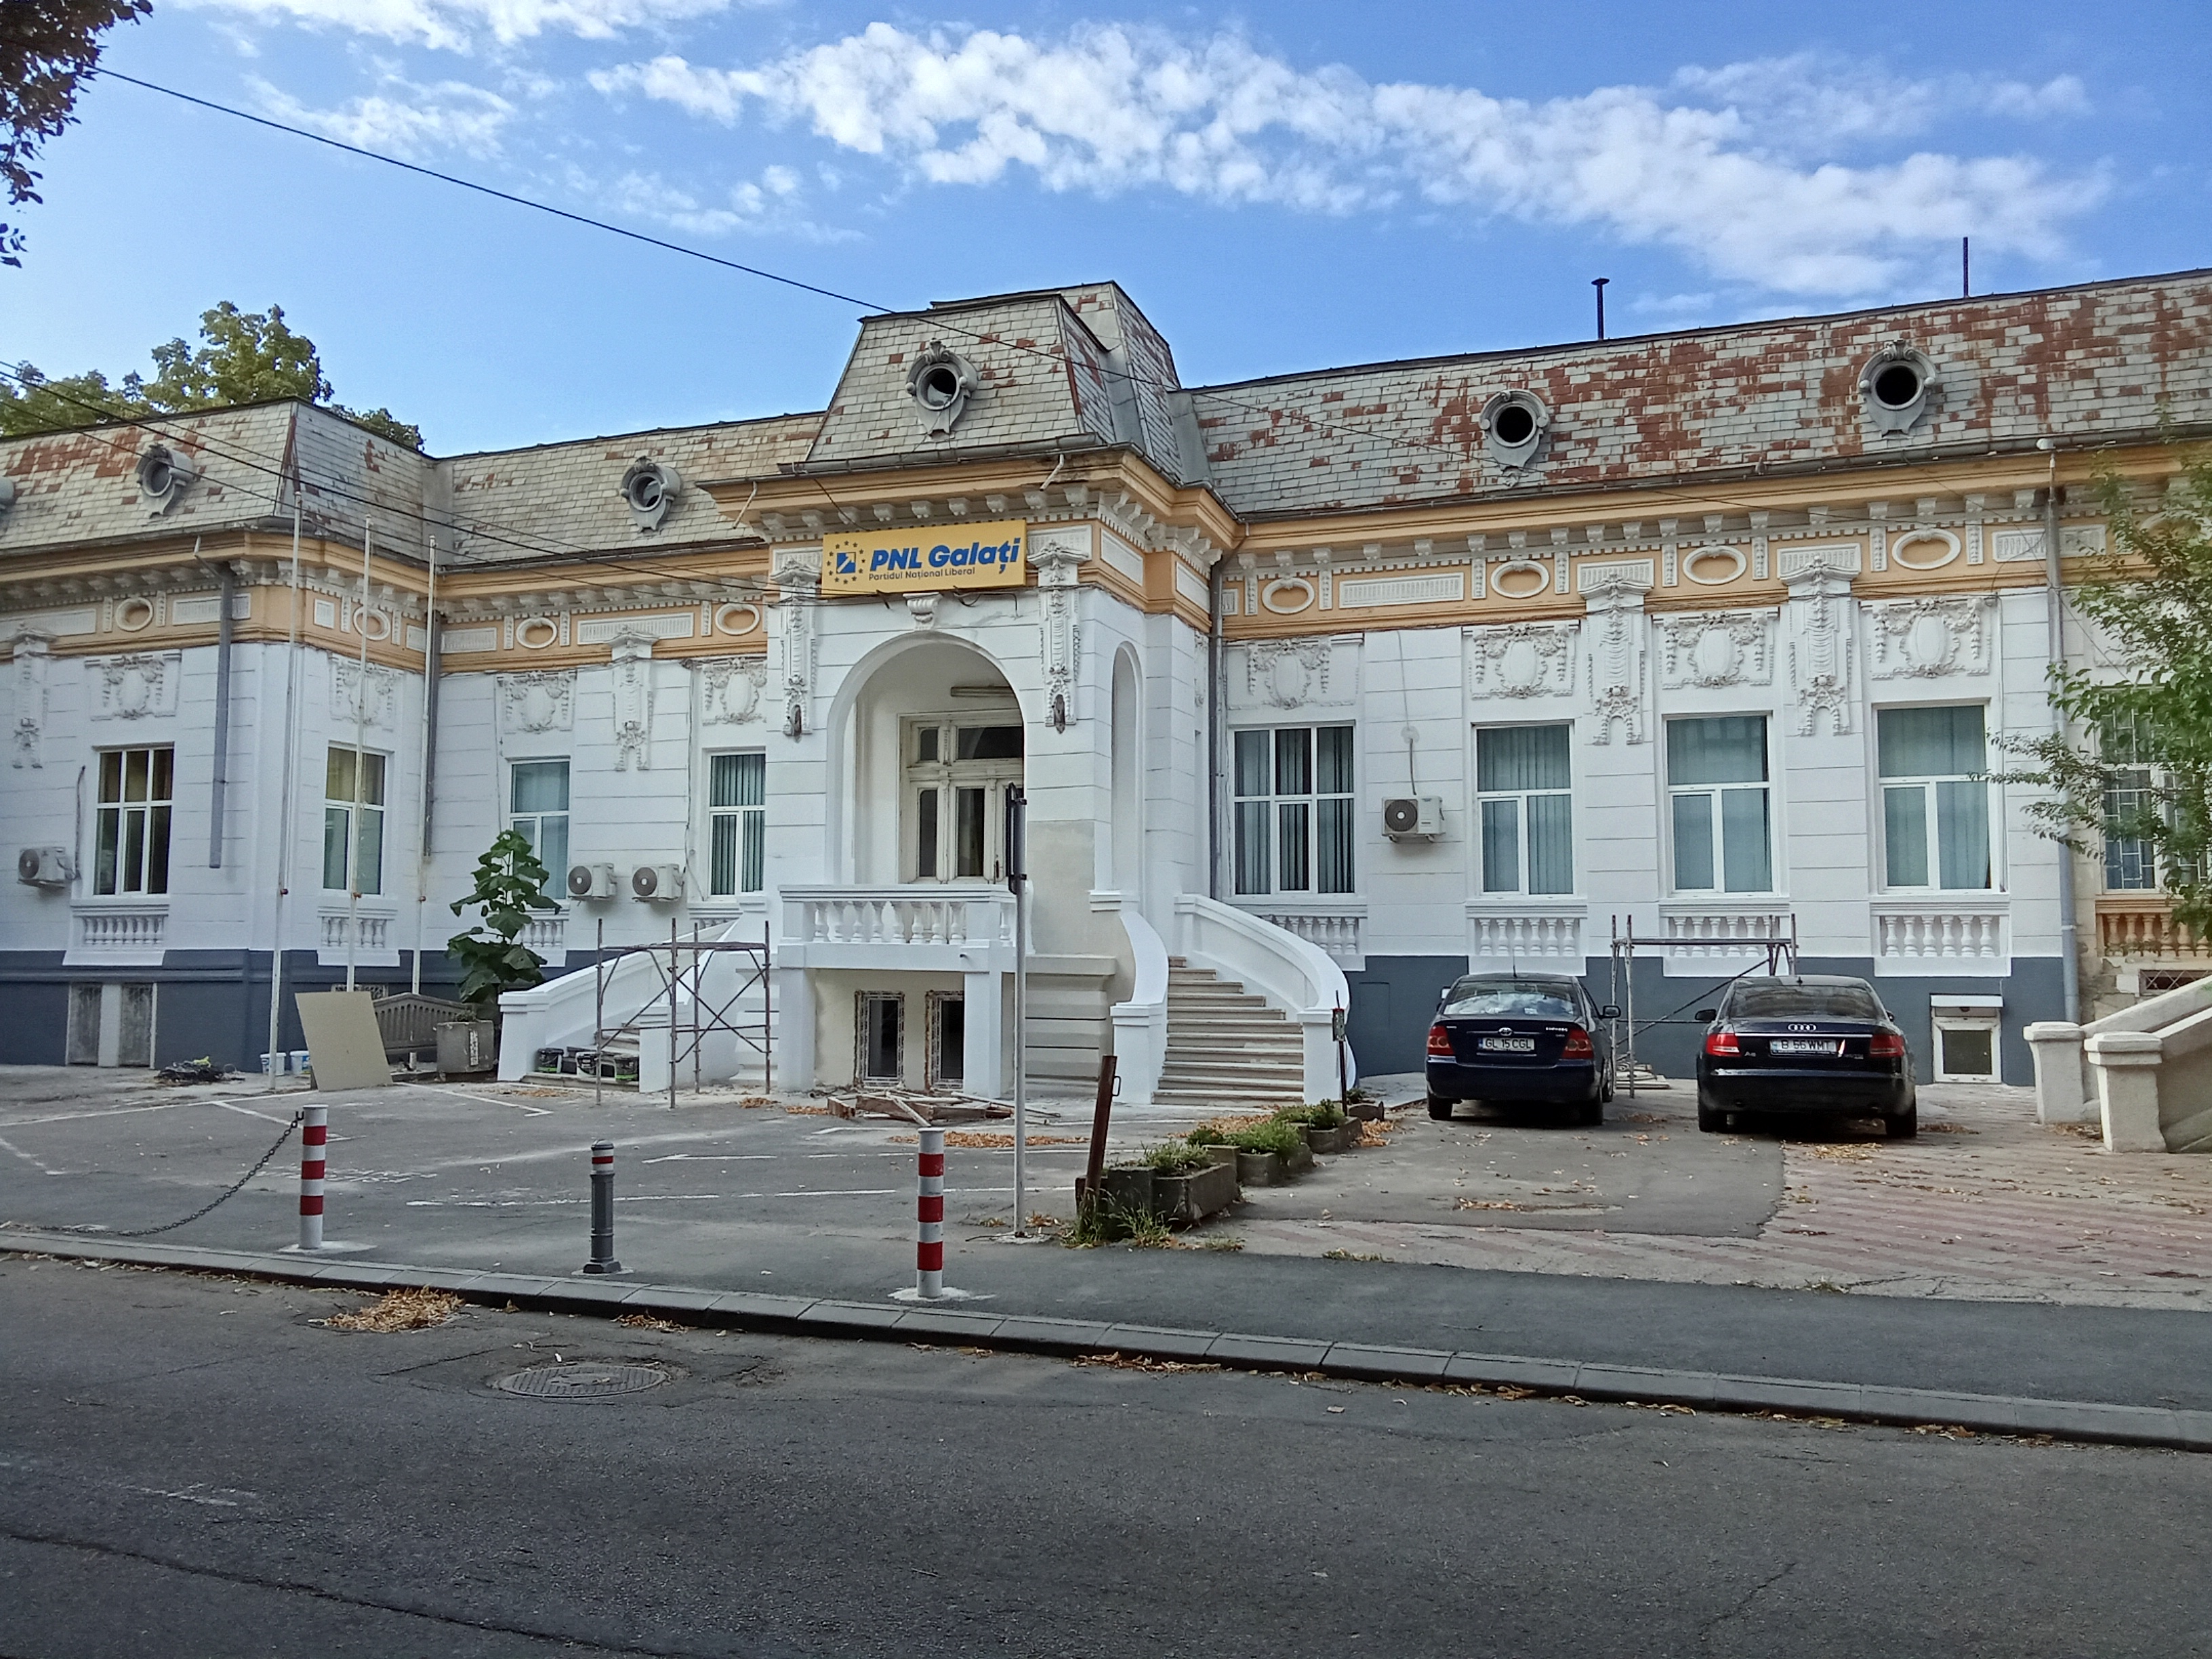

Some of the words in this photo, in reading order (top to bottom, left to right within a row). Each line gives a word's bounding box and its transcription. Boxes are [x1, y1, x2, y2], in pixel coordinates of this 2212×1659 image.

[870, 547, 922, 571] PNL
[928, 537, 1021, 574] Galați
[869, 572, 903, 581] Partidul
[905, 570, 942, 579] Național
[945, 567, 975, 576] Liberal
[1486, 1038, 1498, 1048] GL
[1512, 1038, 1532, 1048] CGL
